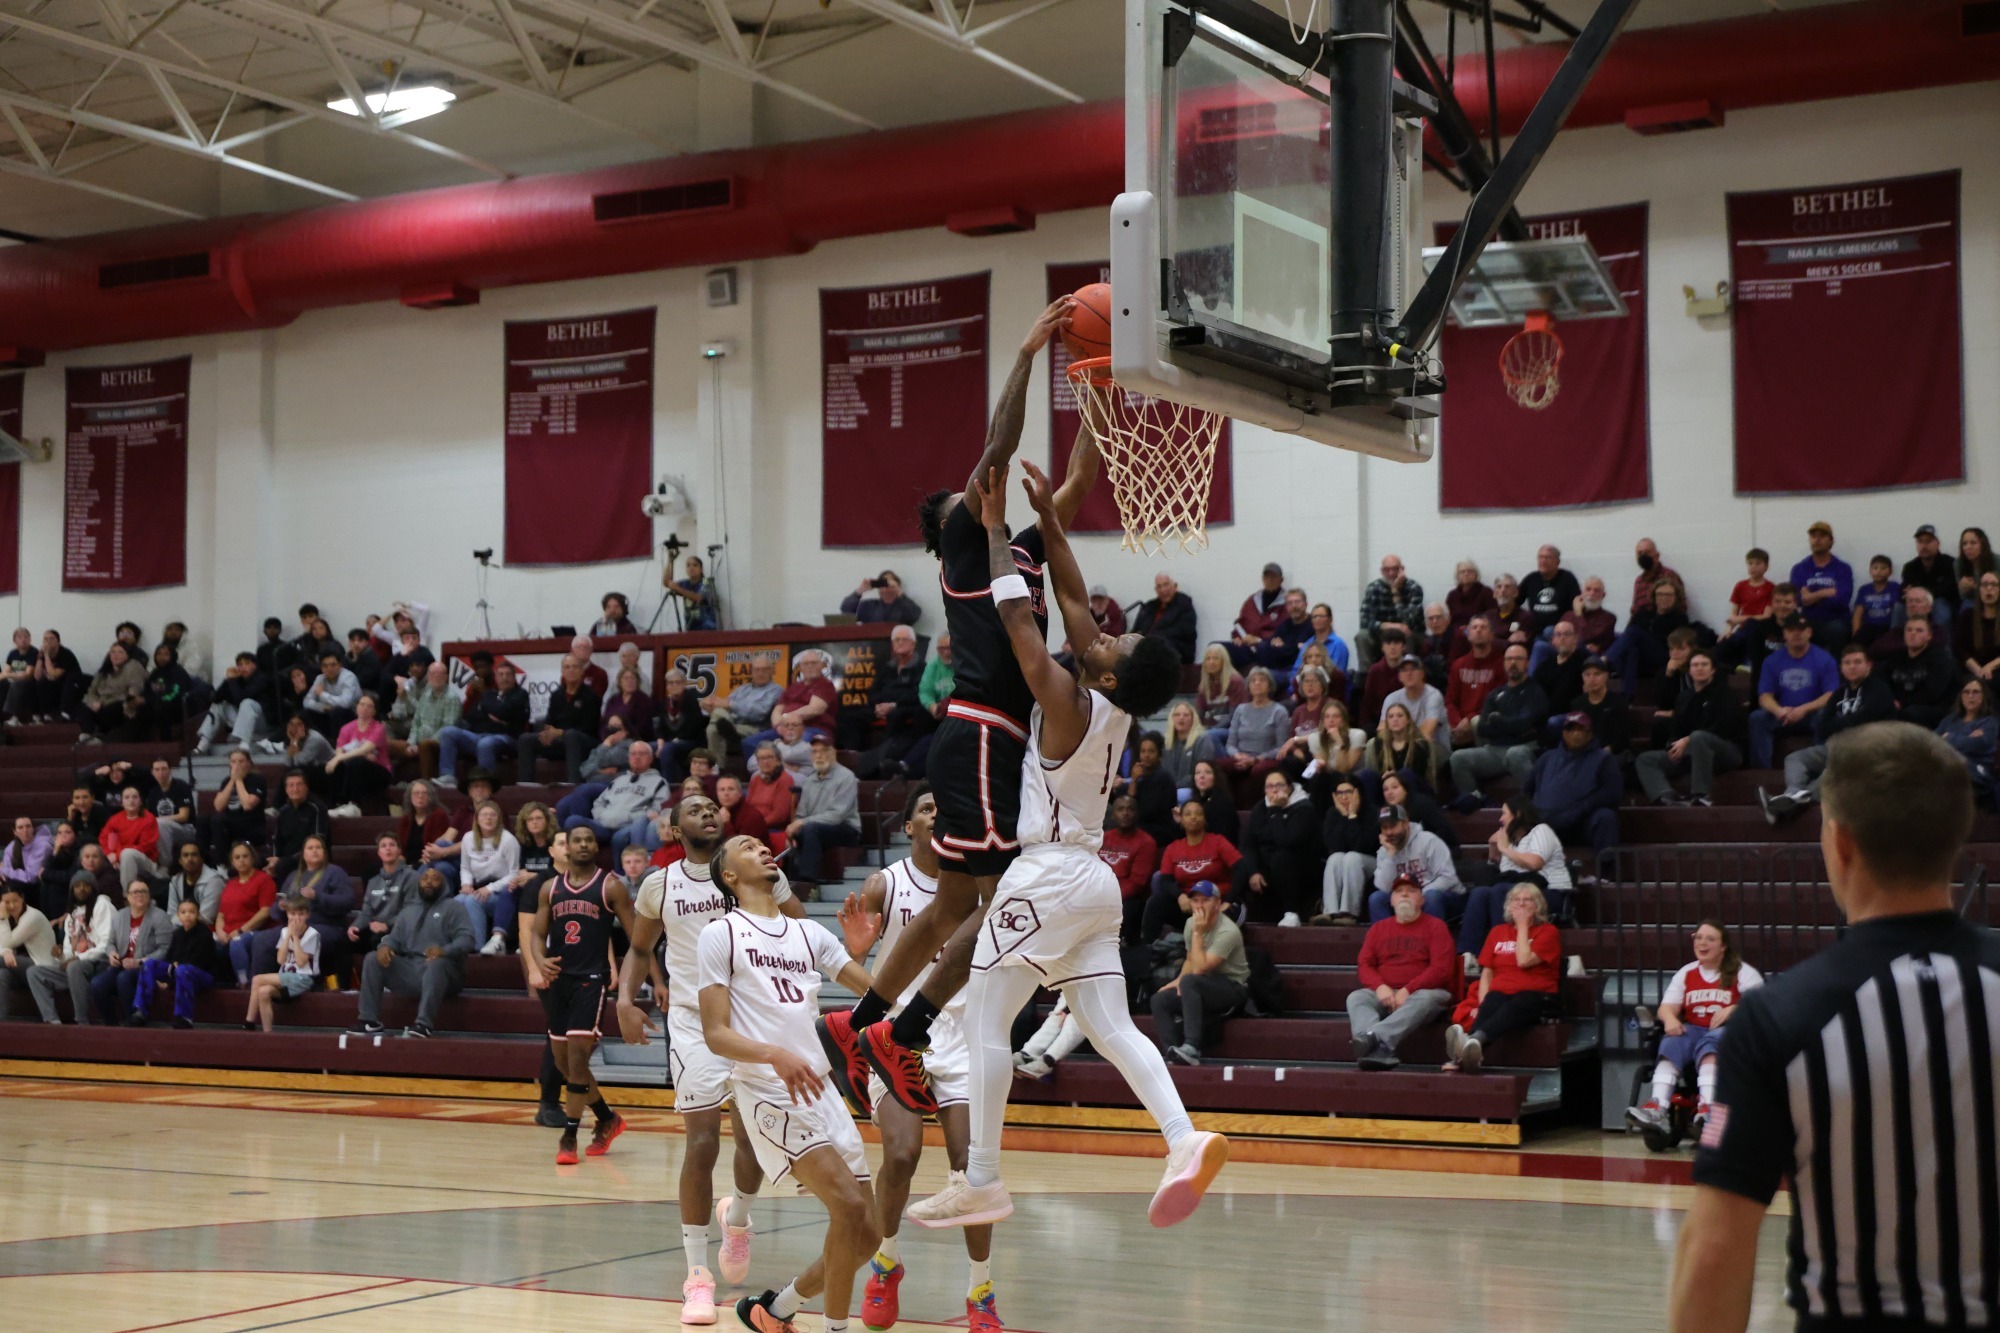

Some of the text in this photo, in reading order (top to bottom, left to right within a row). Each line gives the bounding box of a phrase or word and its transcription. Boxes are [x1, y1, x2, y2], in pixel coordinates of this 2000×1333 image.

[1792, 187, 1893, 215] BETHEL
[1525, 219, 1587, 240] THEL
[1787, 247, 1813, 259] NAIA
[1806, 261, 1882, 278] MEN'S SOCCER
[868, 286, 941, 310] BETHEL
[547, 320, 613, 341] BETHEL
[101, 368, 155, 387] BETHEL
[847, 646, 875, 659] ALL
[1100, 743, 1112, 794] 1
[551, 899, 600, 921] FRIENDS
[997, 910, 1029, 932] BC
[564, 920, 582, 945] 2
[745, 948, 807, 974] Threshers
[771, 976, 805, 1004] 10
[1685, 988, 1733, 1006] FRIENDS
